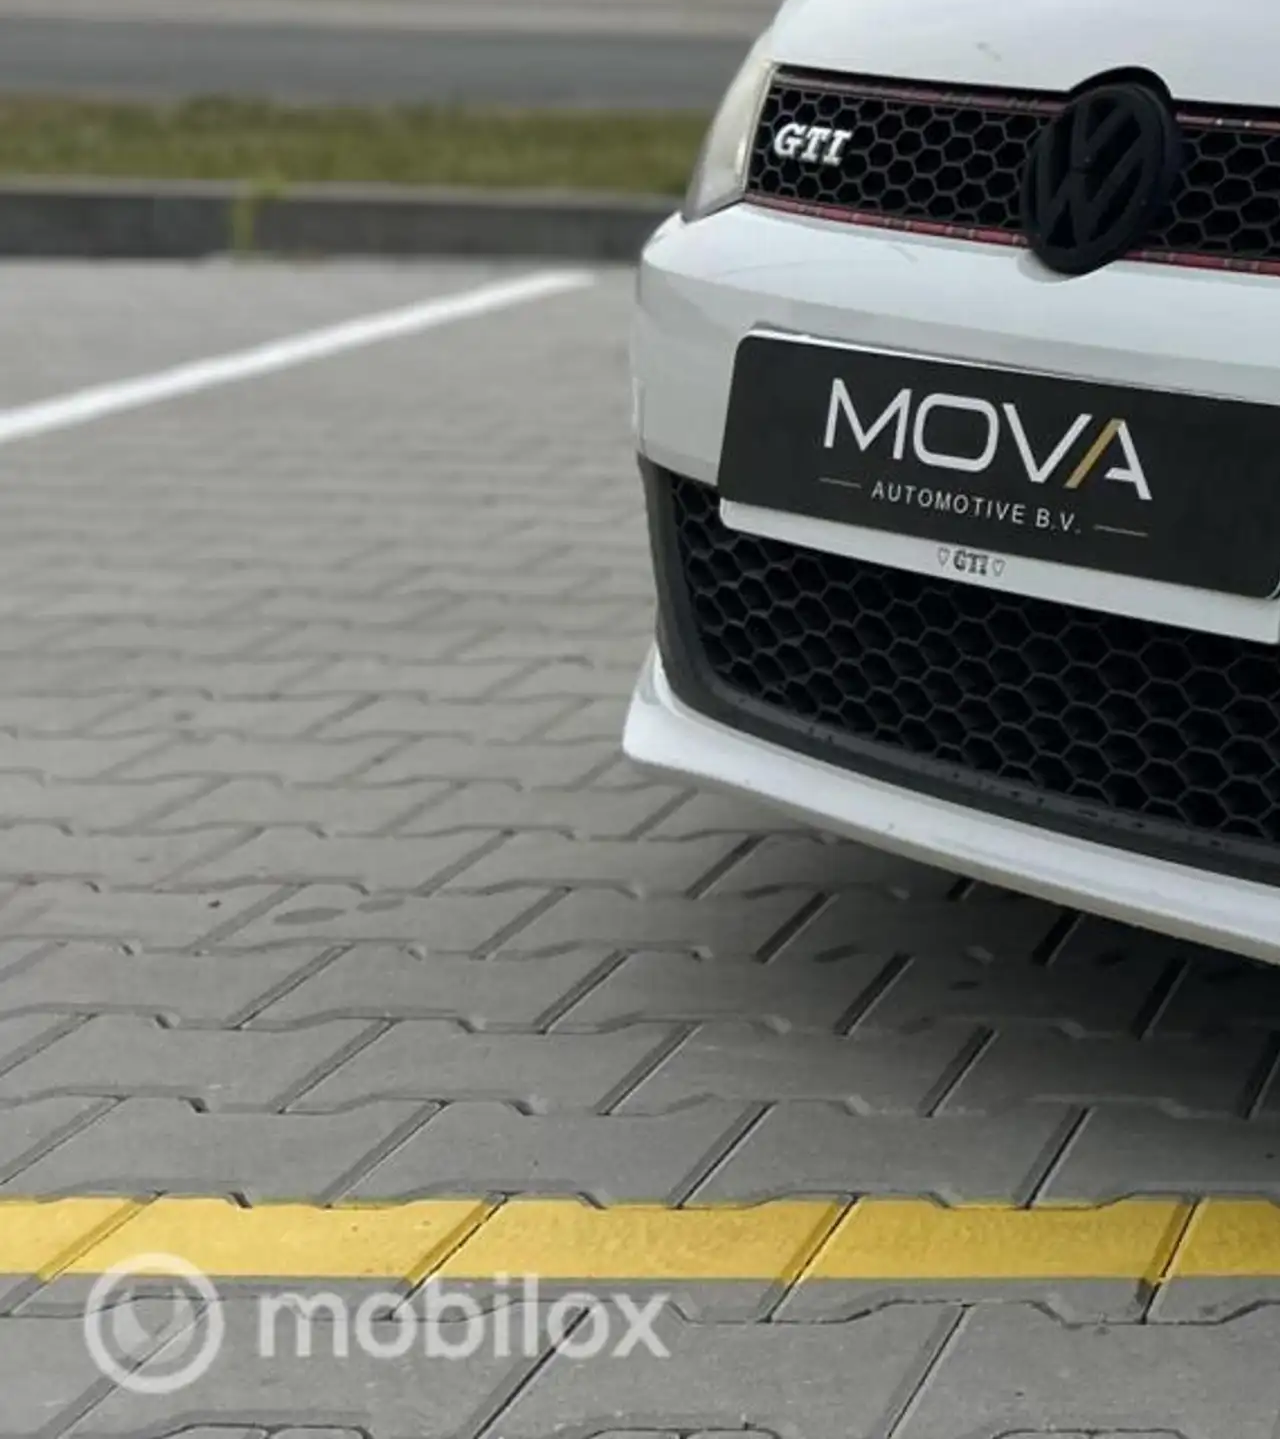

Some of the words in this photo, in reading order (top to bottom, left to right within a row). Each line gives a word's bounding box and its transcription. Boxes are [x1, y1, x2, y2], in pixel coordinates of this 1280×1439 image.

[774, 122, 853, 167] GTI
[823, 377, 1153, 501] MOVA
[870, 480, 1026, 525] AUTOMOTIVE
[1035, 507, 1082, 534] B.V.
